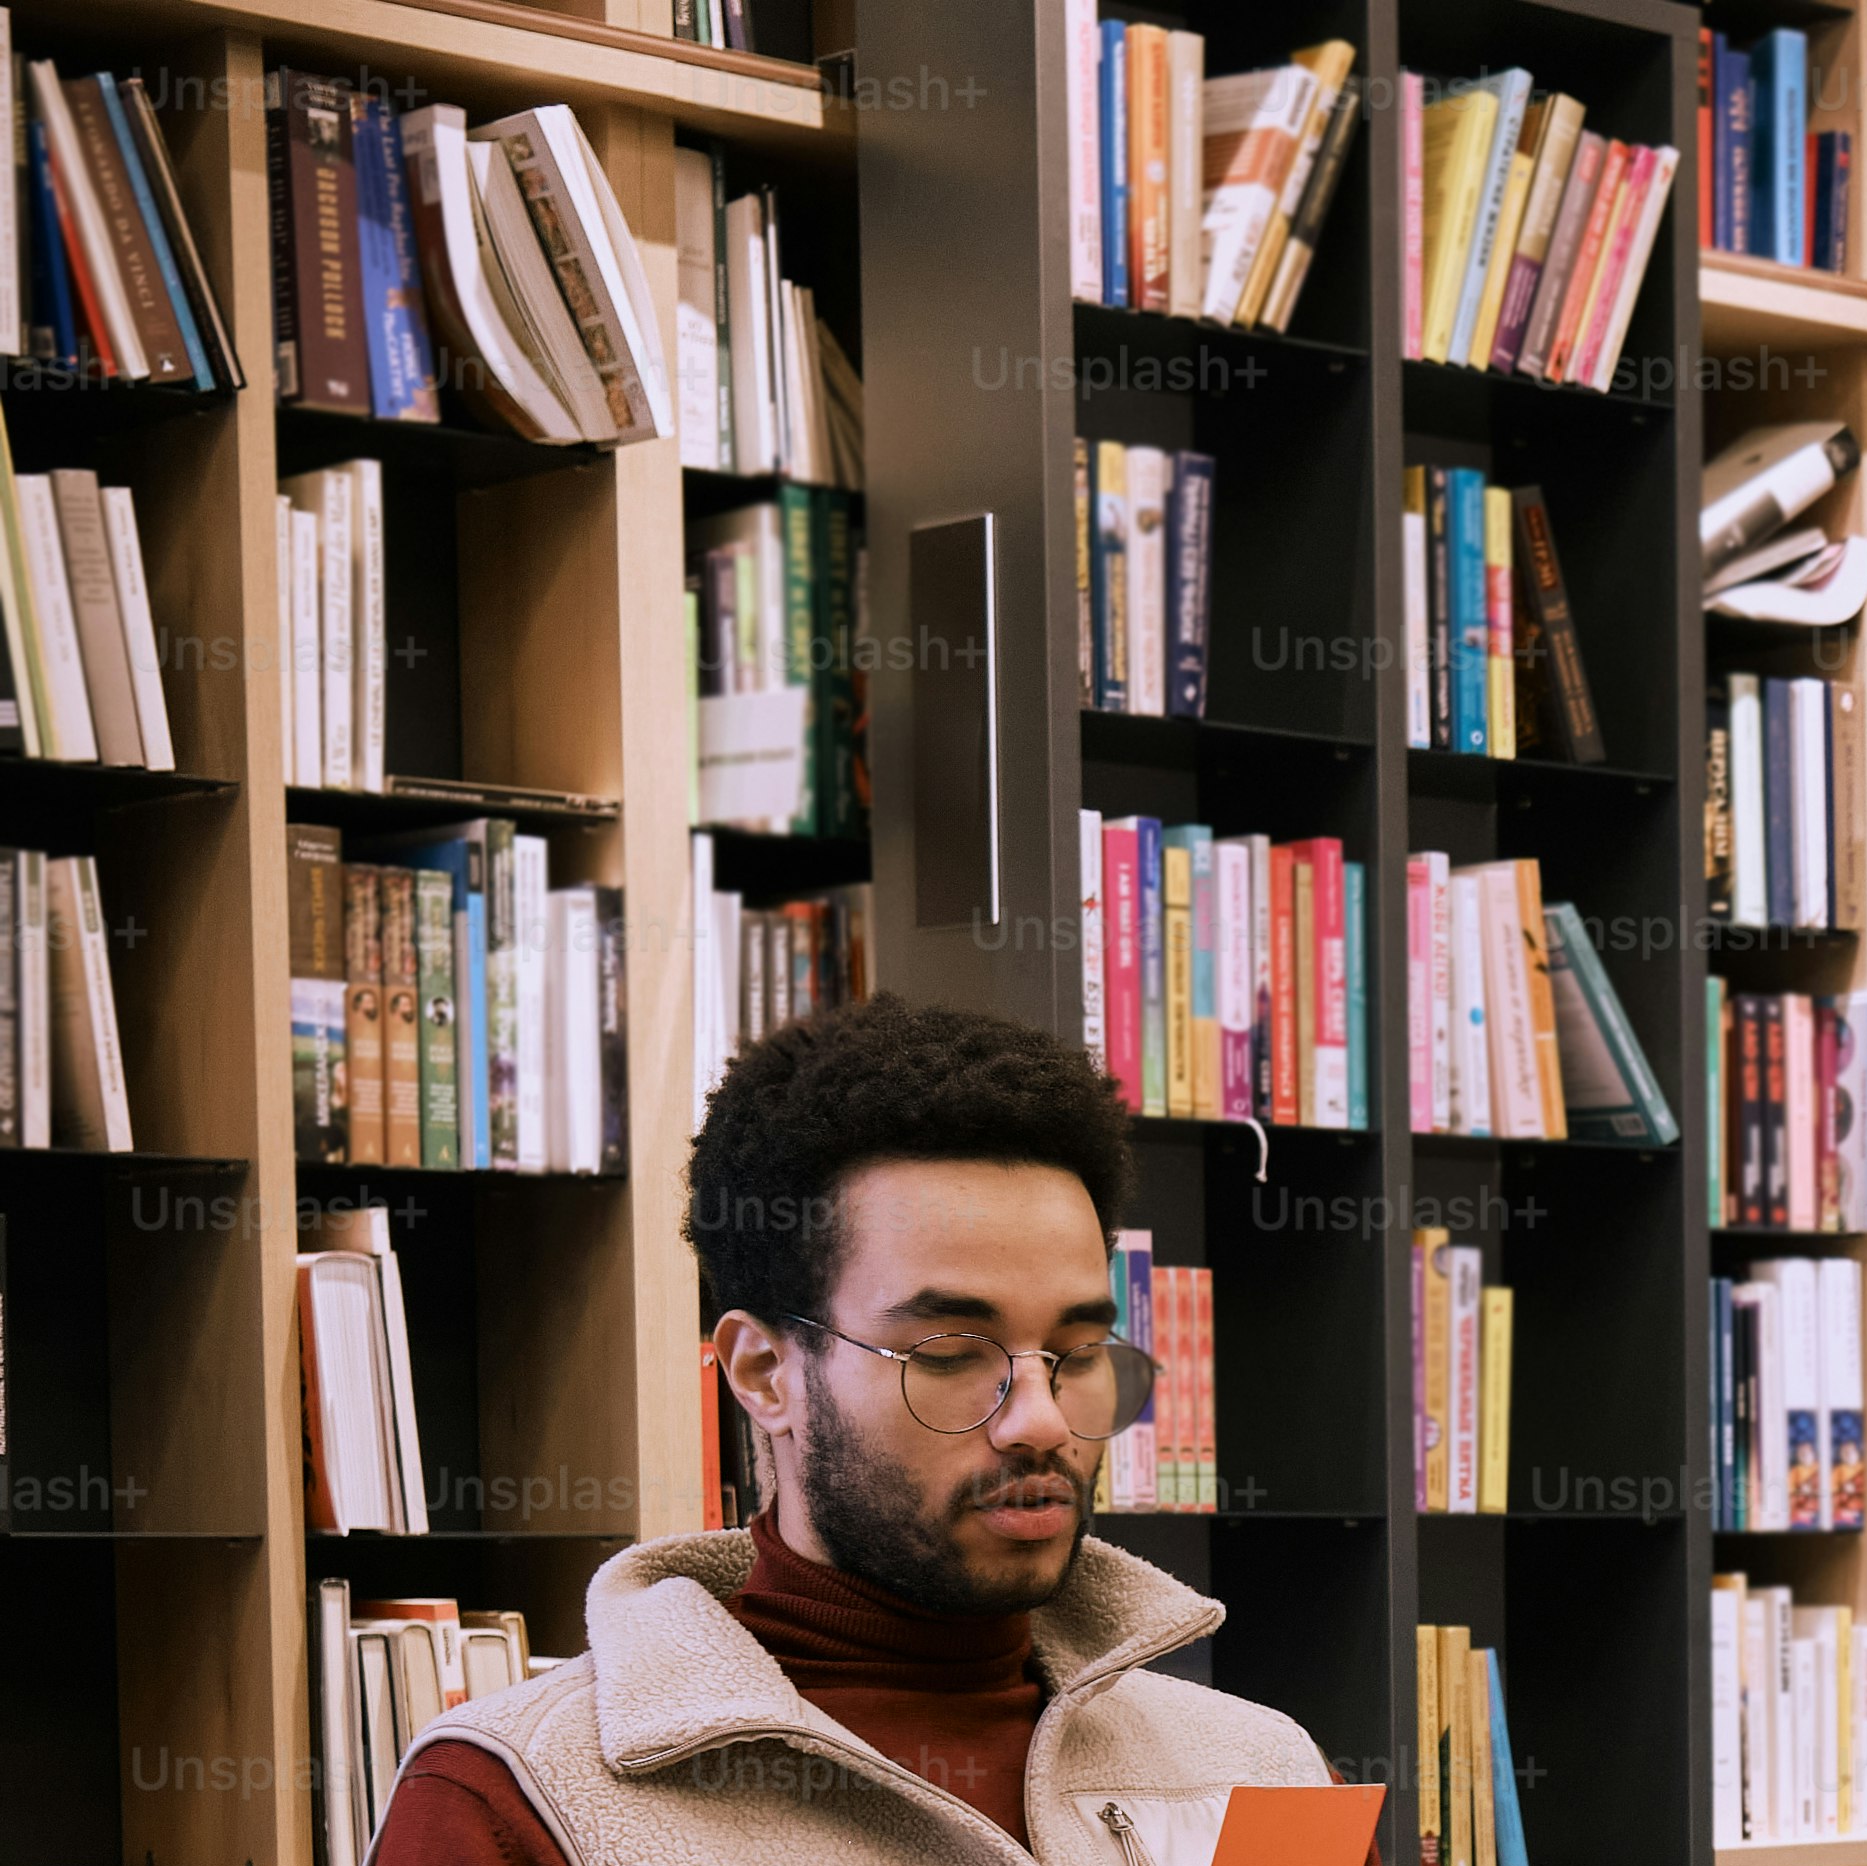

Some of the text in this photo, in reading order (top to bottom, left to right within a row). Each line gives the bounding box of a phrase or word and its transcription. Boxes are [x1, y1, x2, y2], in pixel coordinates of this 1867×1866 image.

[114, 215, 134, 247] DA
[125, 249, 155, 310] VINCI
[321, 259, 346, 340] POLLOCK
